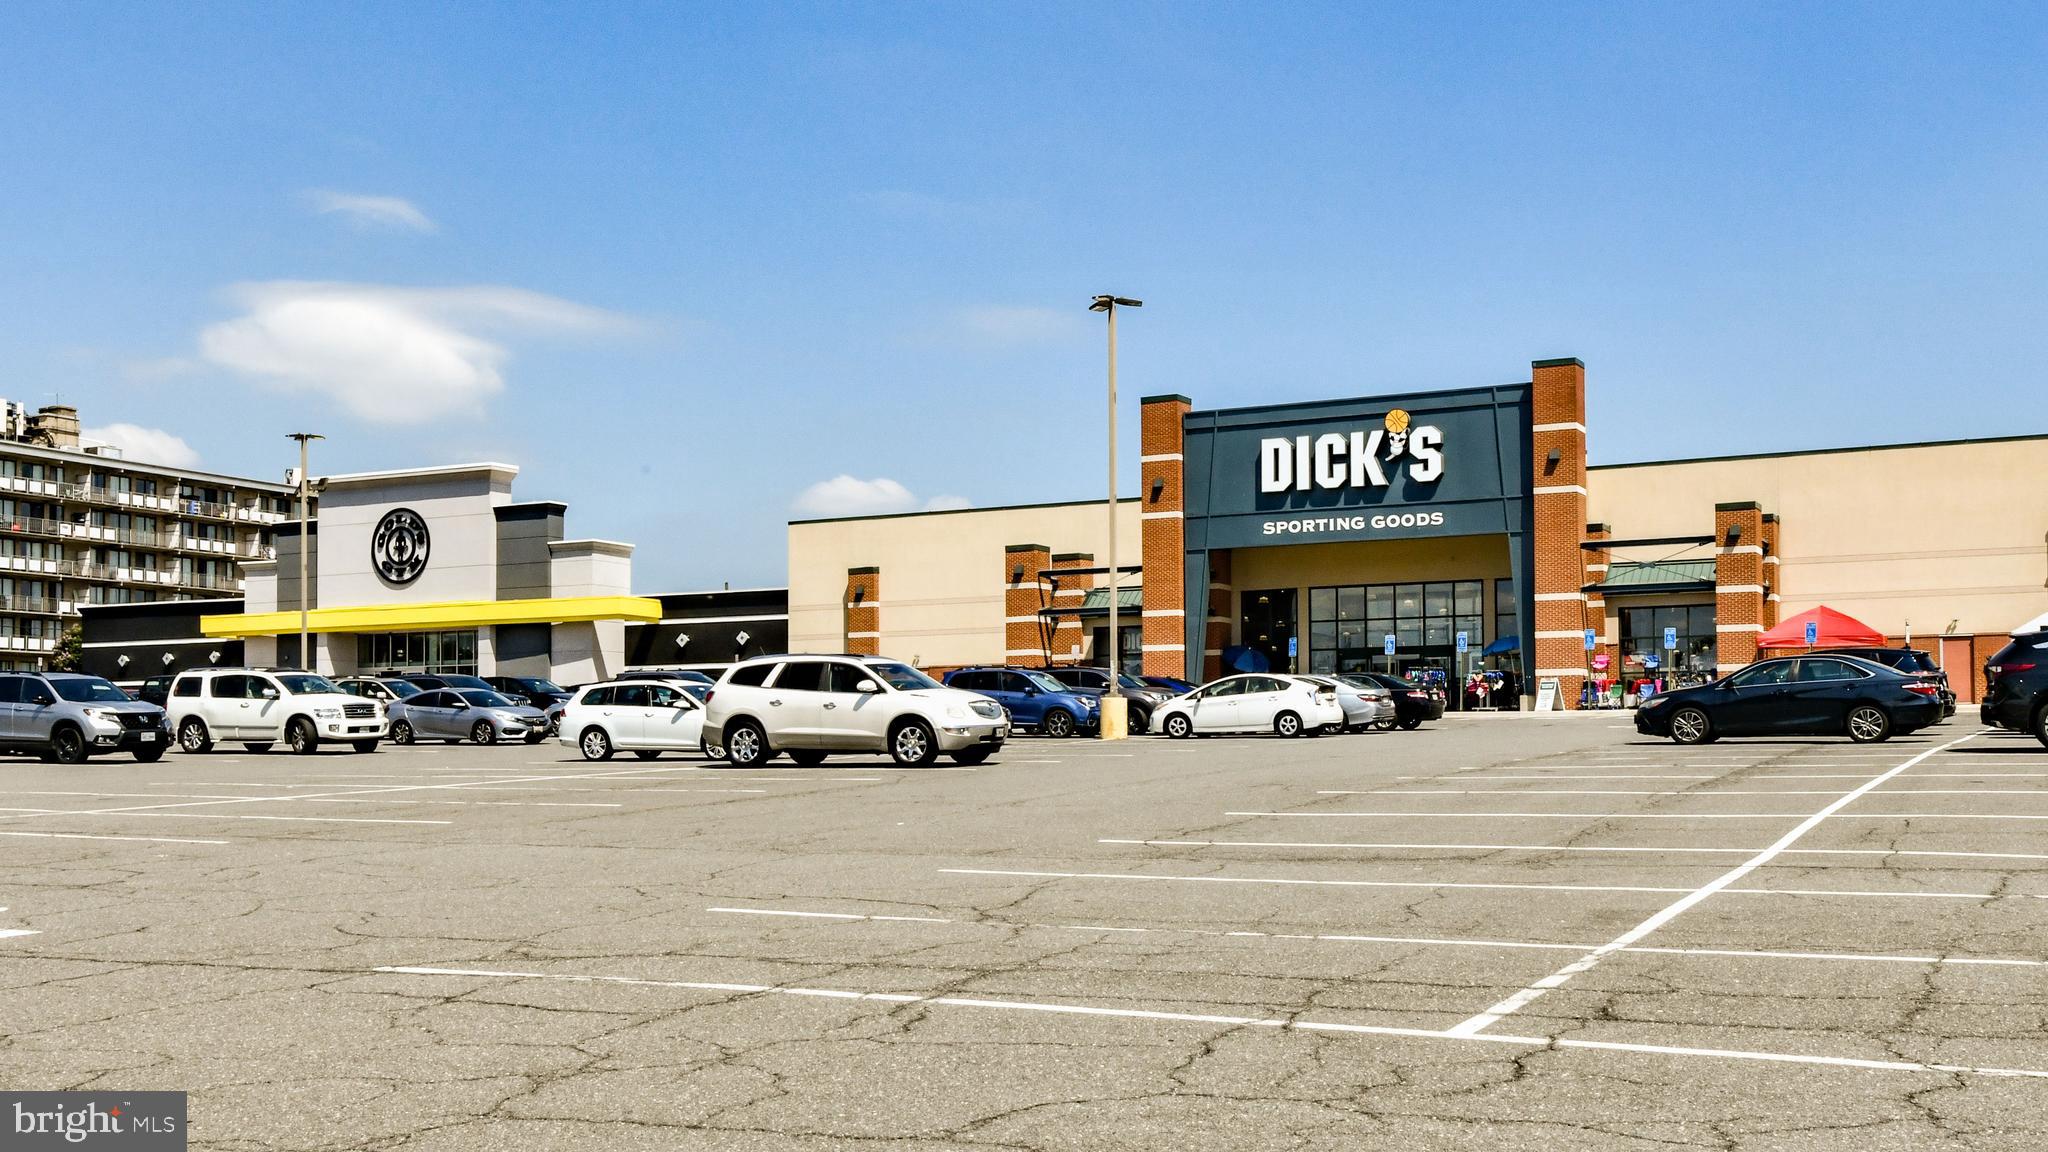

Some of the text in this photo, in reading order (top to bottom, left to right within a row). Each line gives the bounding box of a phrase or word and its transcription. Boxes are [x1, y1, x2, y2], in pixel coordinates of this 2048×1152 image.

[1261, 425, 1444, 493] DICK'S
[1263, 512, 1444, 535] SPORTING GOODS
[381, 554, 423, 579] GYM
